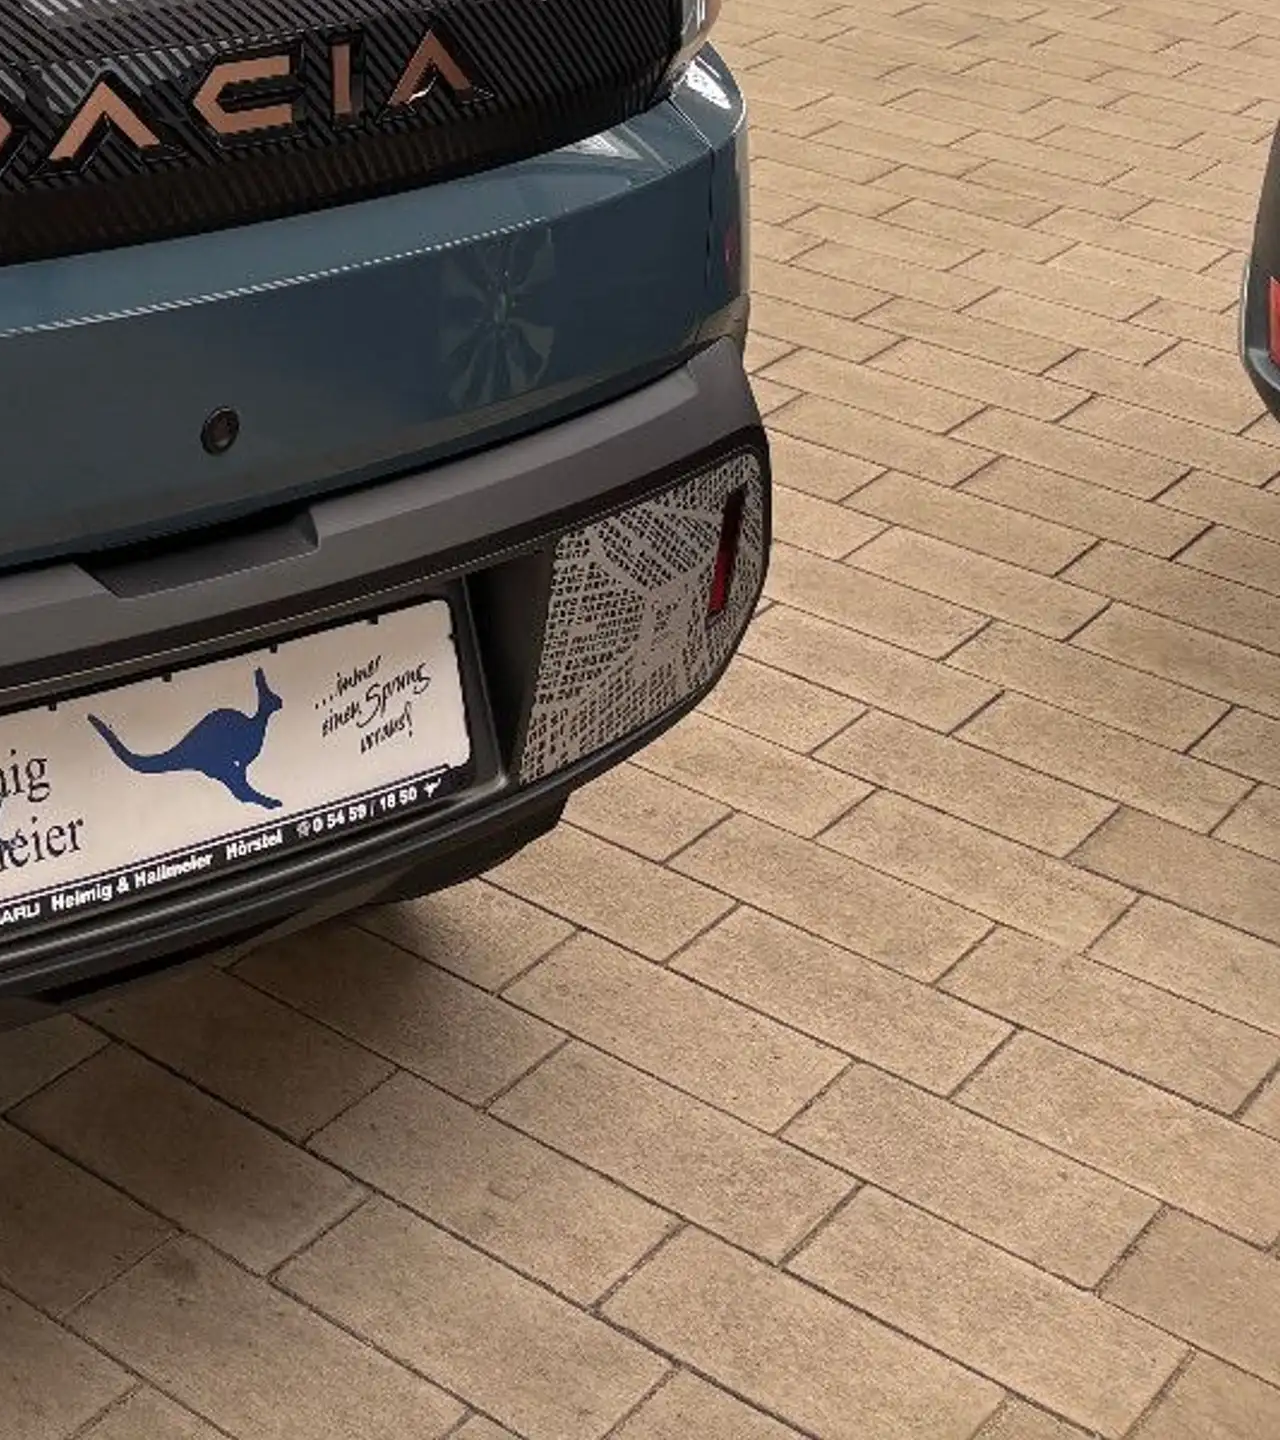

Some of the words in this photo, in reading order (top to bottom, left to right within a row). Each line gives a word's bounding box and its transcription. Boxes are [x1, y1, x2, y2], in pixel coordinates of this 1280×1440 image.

[50, 879, 114, 913] Helmig
[116, 871, 130, 894] &
[135, 851, 214, 889] Hallmeier
[225, 830, 283, 861] Hörstel
